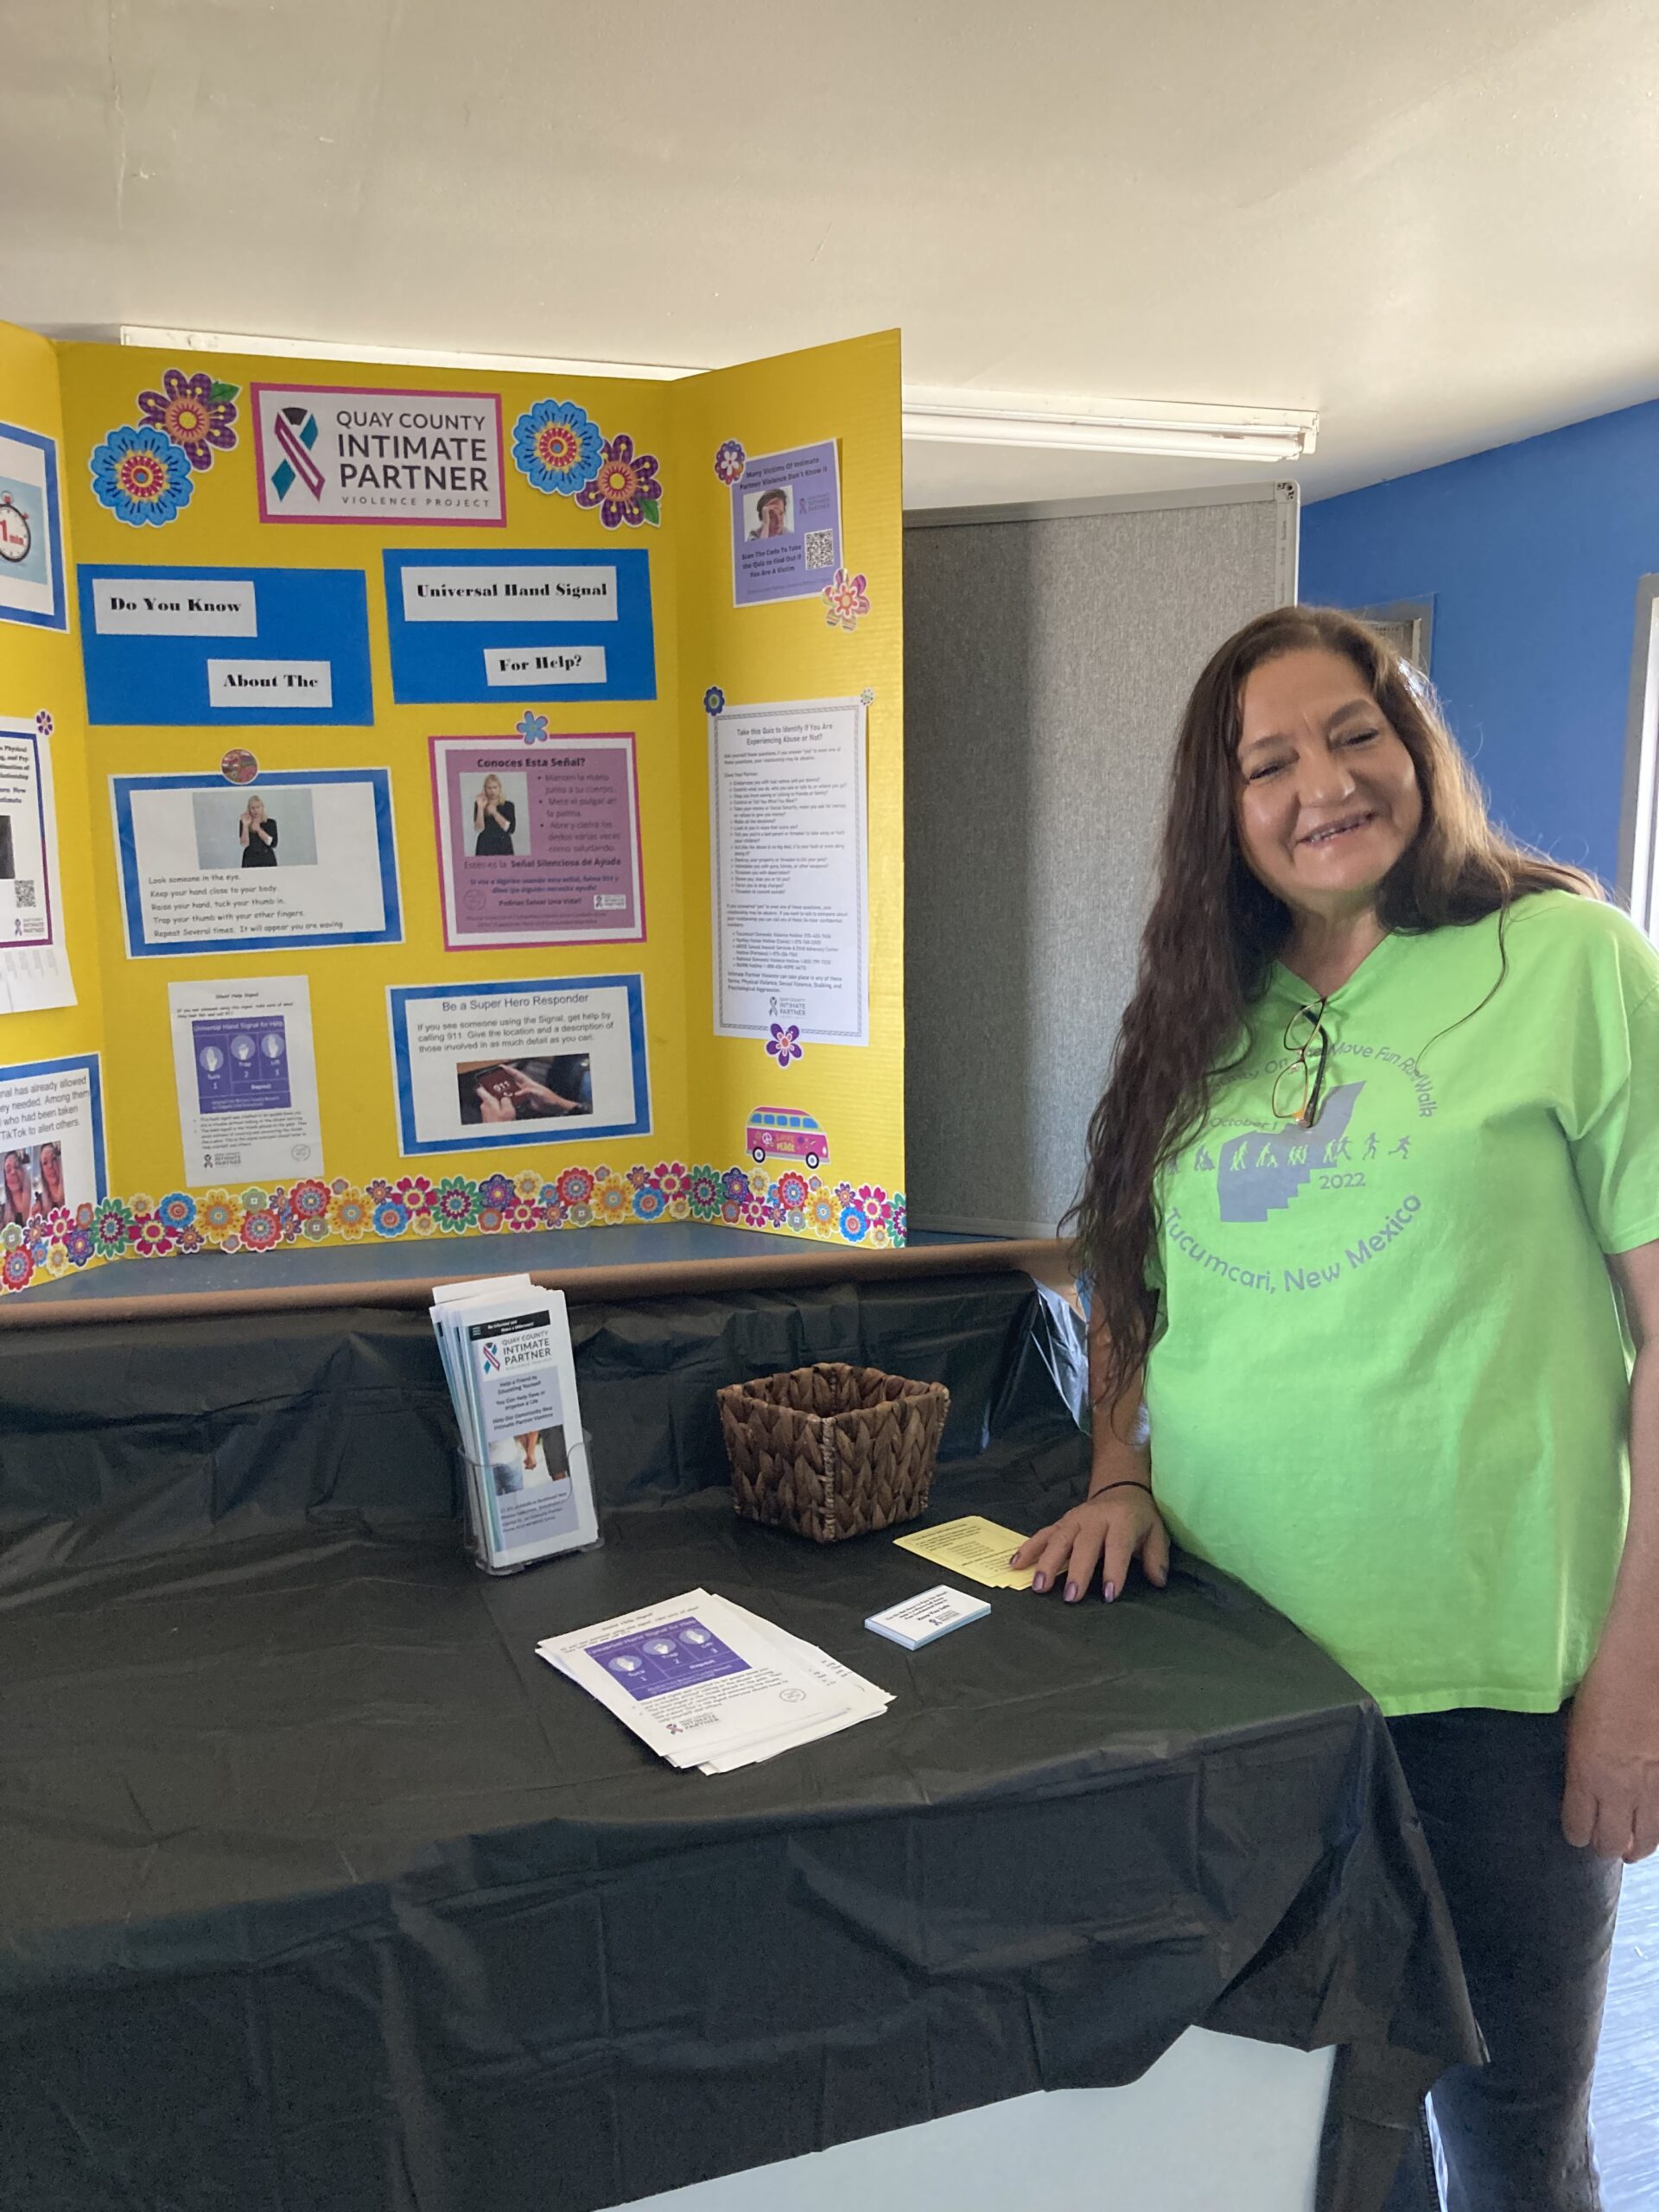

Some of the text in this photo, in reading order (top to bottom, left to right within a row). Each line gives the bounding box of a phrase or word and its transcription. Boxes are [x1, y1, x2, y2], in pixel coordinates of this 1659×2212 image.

[336, 410, 486, 430] QUAY COUNTY
[338, 434, 486, 461] INTIMATE
[340, 463, 489, 492] PARTNER
[762, 476, 786, 486] Violence
[341, 496, 489, 507] VIOLENCE PROJECT
[416, 582, 607, 599] Universal Hand Signal
[110, 597, 242, 612] Do You Know
[499, 654, 582, 671] For Help?
[223, 674, 318, 688] About The
[477, 757, 586, 767] Conoces Esta Señal?
[582, 858, 592, 867] de
[594, 857, 621, 868] Ayuda
[170, 890, 187, 899] your
[240, 887, 256, 895] your
[154, 930, 180, 938] Repeat
[183, 927, 210, 936] Several
[442, 994, 588, 1012] Be a Super Hero Responder
[499, 1018, 521, 1027] using
[568, 1014, 580, 1023] get
[601, 1012, 611, 1020] by
[418, 1033, 445, 1043] calling
[537, 1026, 551, 1034] and
[561, 1023, 604, 1033] description
[444, 1042, 478, 1051] involved
[526, 1037, 547, 1046] detail
[562, 1036, 575, 1045] you
[1332, 1042, 1373, 1058] Move
[1375, 1046, 1402, 1066] Fun
[15, 1076, 86, 1096] has already allowed
[493, 1081, 511, 1091] 911
[45, 1093, 70, 1104] Among
[72, 1090, 89, 1100] them
[3, 1105, 78, 1126] who had been taken
[0, 1128, 26, 1140] TikTok
[29, 1126, 35, 1135] to
[38, 1122, 54, 1134] alert
[1319, 1173, 1366, 1189] 2022
[1165, 1195, 1421, 1294] Tucumcari, New Mexico
[501, 1331, 549, 1346] QUAY COUNTY
[503, 1338, 550, 1355] INTIMATE
[505, 1348, 551, 1364] PARTNER
